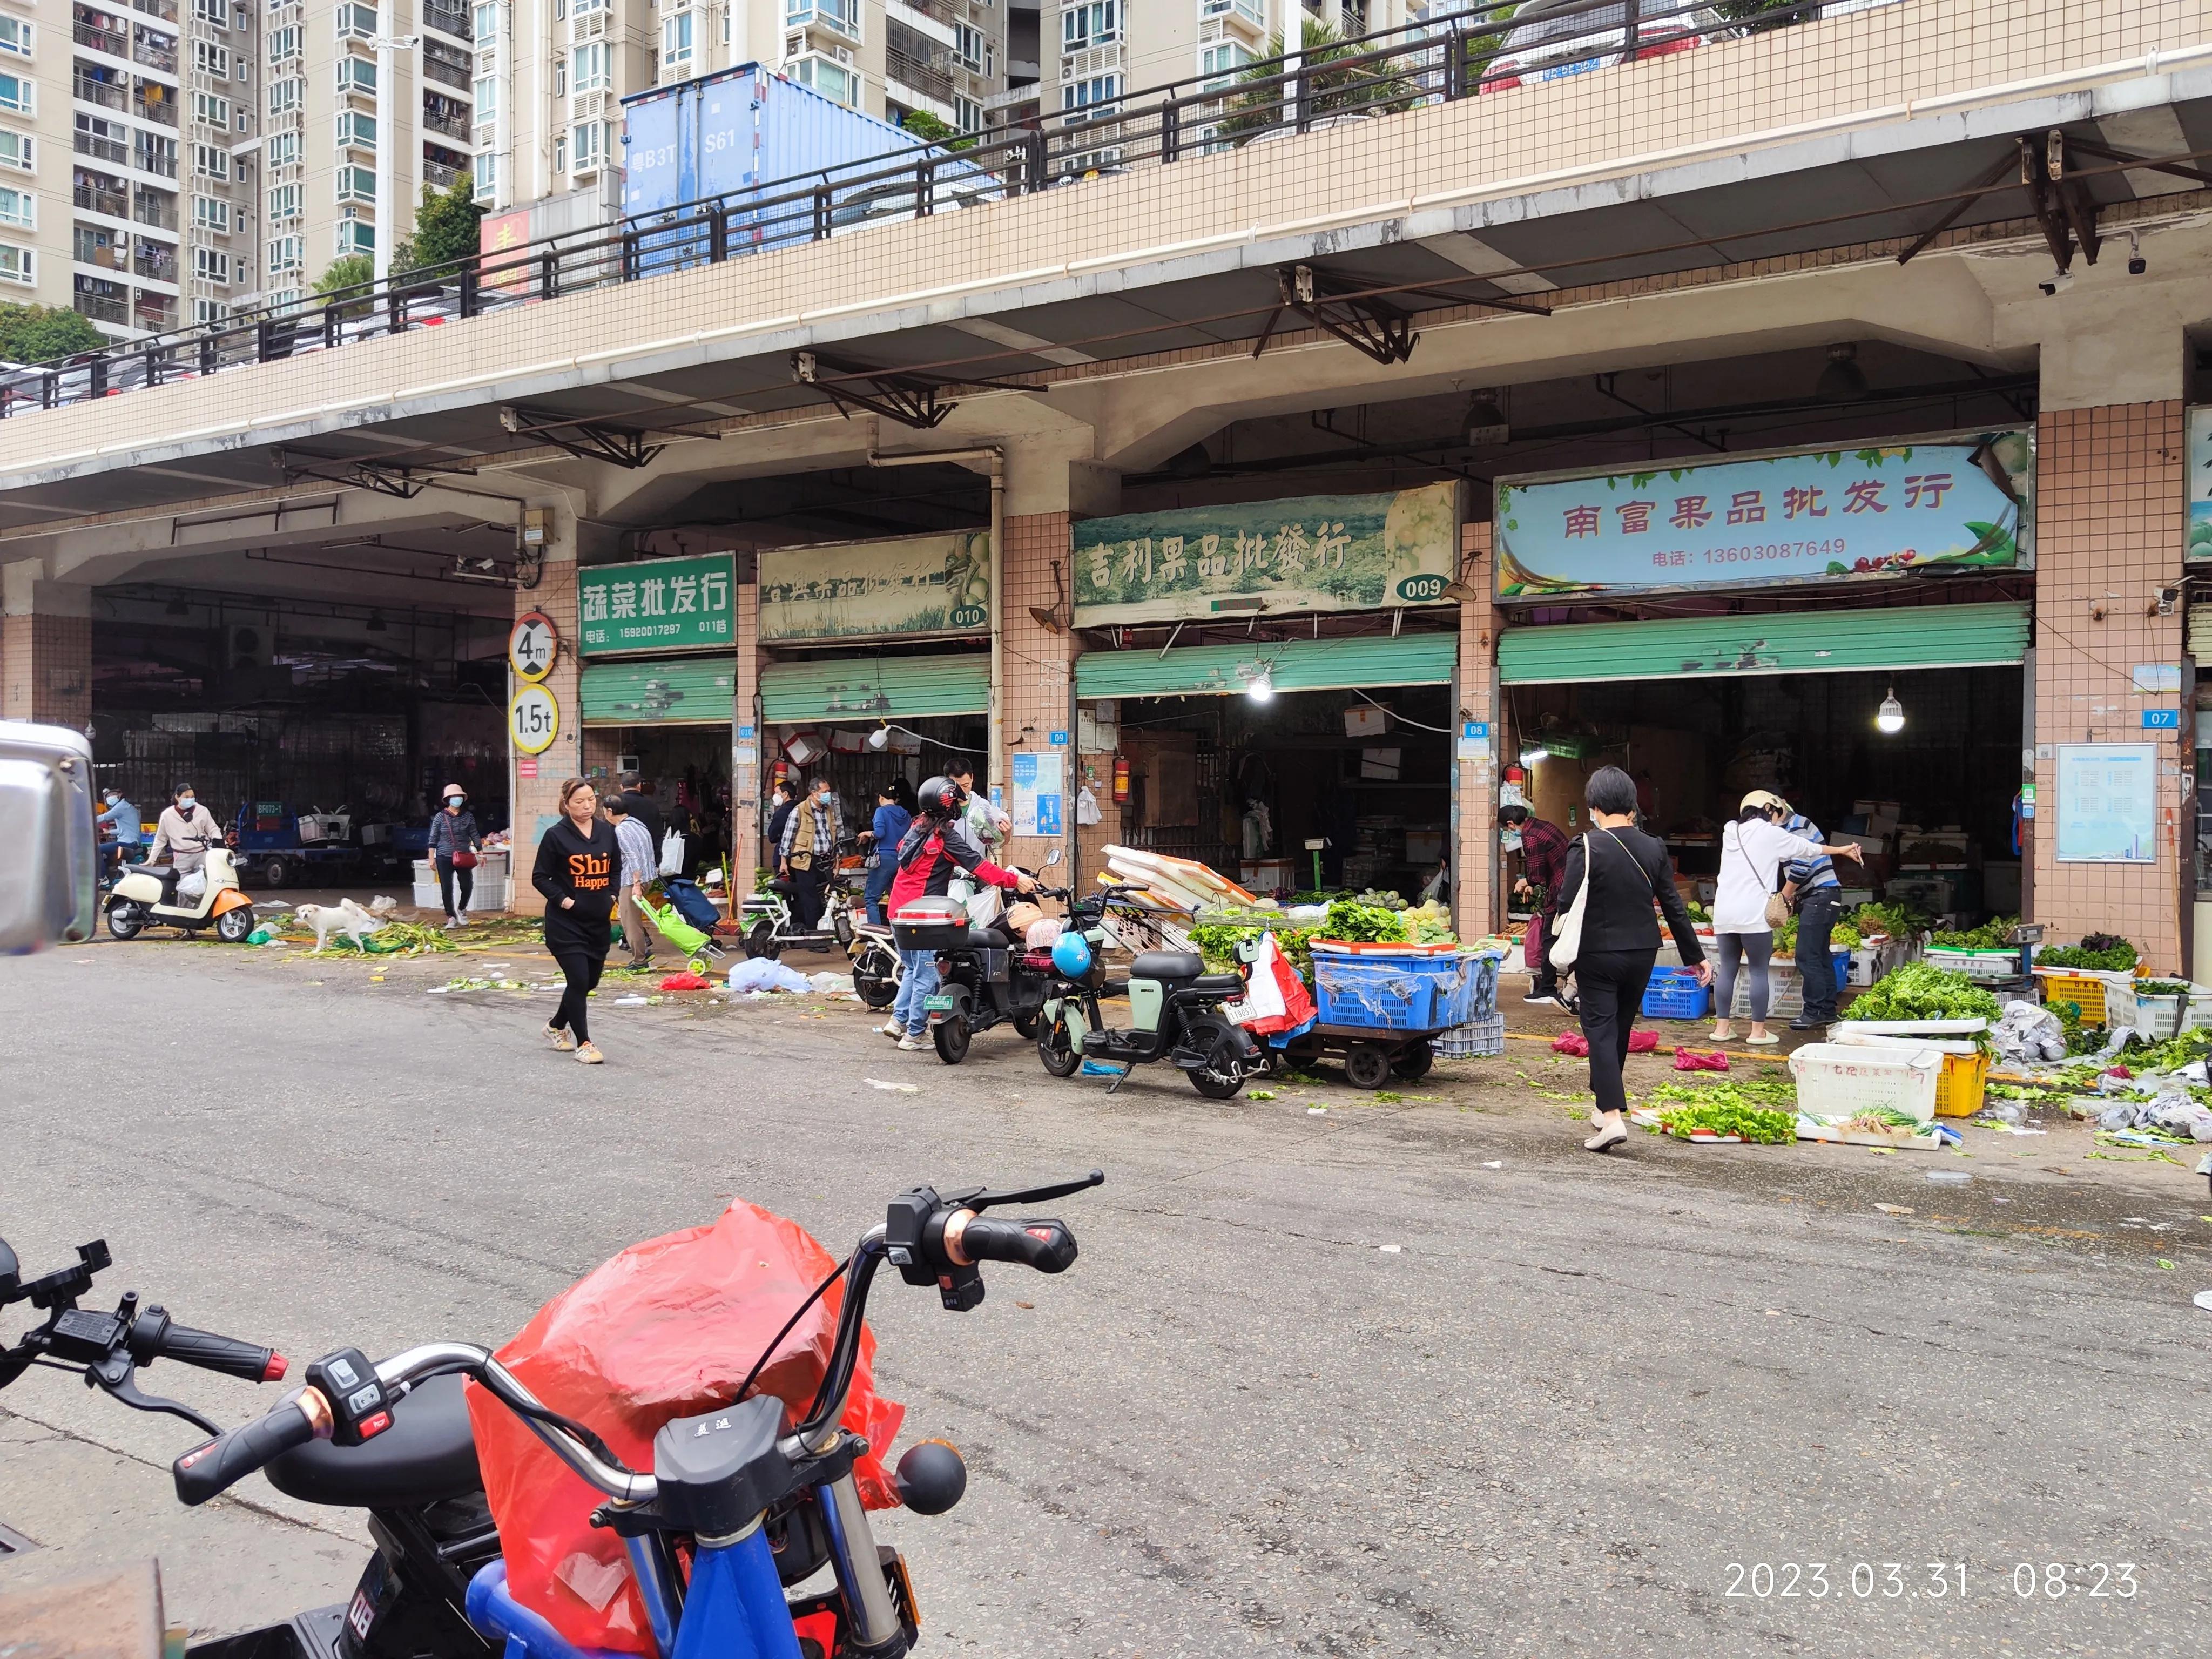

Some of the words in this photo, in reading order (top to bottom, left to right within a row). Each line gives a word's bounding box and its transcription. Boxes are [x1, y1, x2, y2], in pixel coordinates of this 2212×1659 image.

[704, 129, 735, 153] S61
[1563, 473, 1953, 539] 南富果品批发行
[1089, 521, 1352, 588] 吉利果品批發行
[1703, 538, 1845, 564] 13603087649
[583, 572, 727, 621] 蔬菜批发行
[1406, 579, 1441, 597] 009
[955, 609, 980, 624] 010
[515, 704, 551, 734] 1.5t
[1471, 725, 1483, 735] 08
[2152, 713, 2169, 725] 07
[1054, 734, 1064, 743] 09
